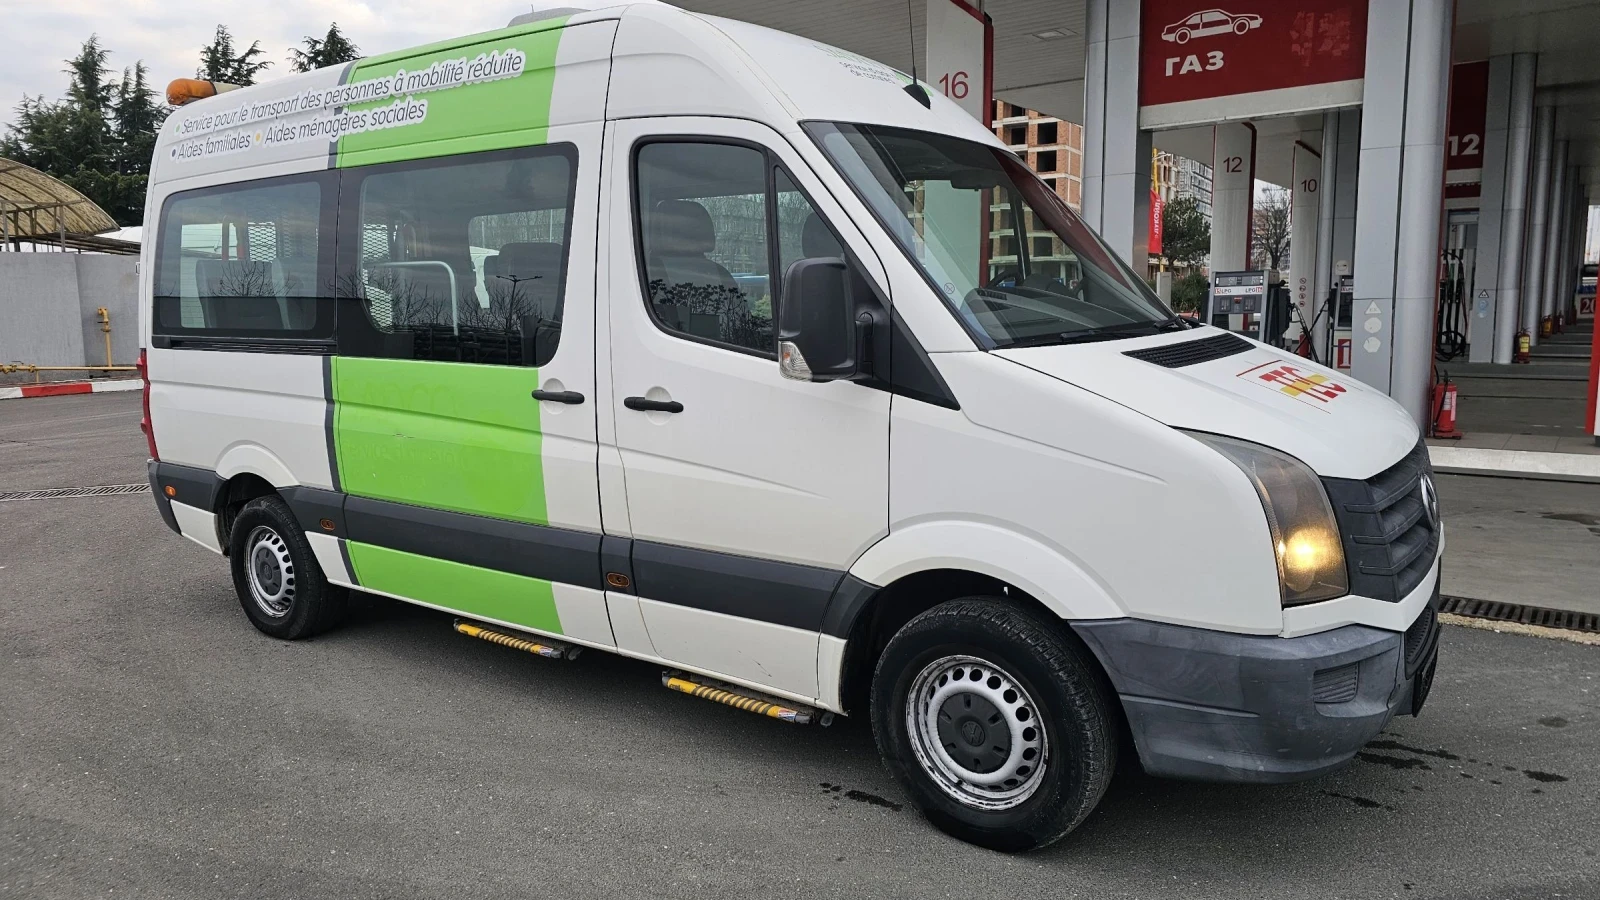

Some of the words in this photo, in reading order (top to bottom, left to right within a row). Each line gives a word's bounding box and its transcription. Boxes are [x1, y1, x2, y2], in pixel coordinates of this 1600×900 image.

[1165, 50, 1225, 77] ГАЗ
[181, 115, 213, 134] Service
[213, 111, 237, 132] pour
[237, 105, 248, 122] le
[250, 94, 300, 120] transport
[300, 90, 322, 110] des
[323, 79, 391, 111] personnes
[394, 73, 404, 92] à
[406, 60, 464, 90] mobilité
[466, 53, 522, 80] réduite
[938, 71, 969, 99] 16
[264, 123, 296, 144] Aides
[298, 112, 367, 138] ménagères
[370, 100, 426, 127] sociales
[177, 141, 203, 160] Aides
[204, 131, 251, 155] familiales
[1448, 133, 1480, 157] 12
[1223, 156, 1242, 173] 12
[1301, 179, 1318, 192] 10
